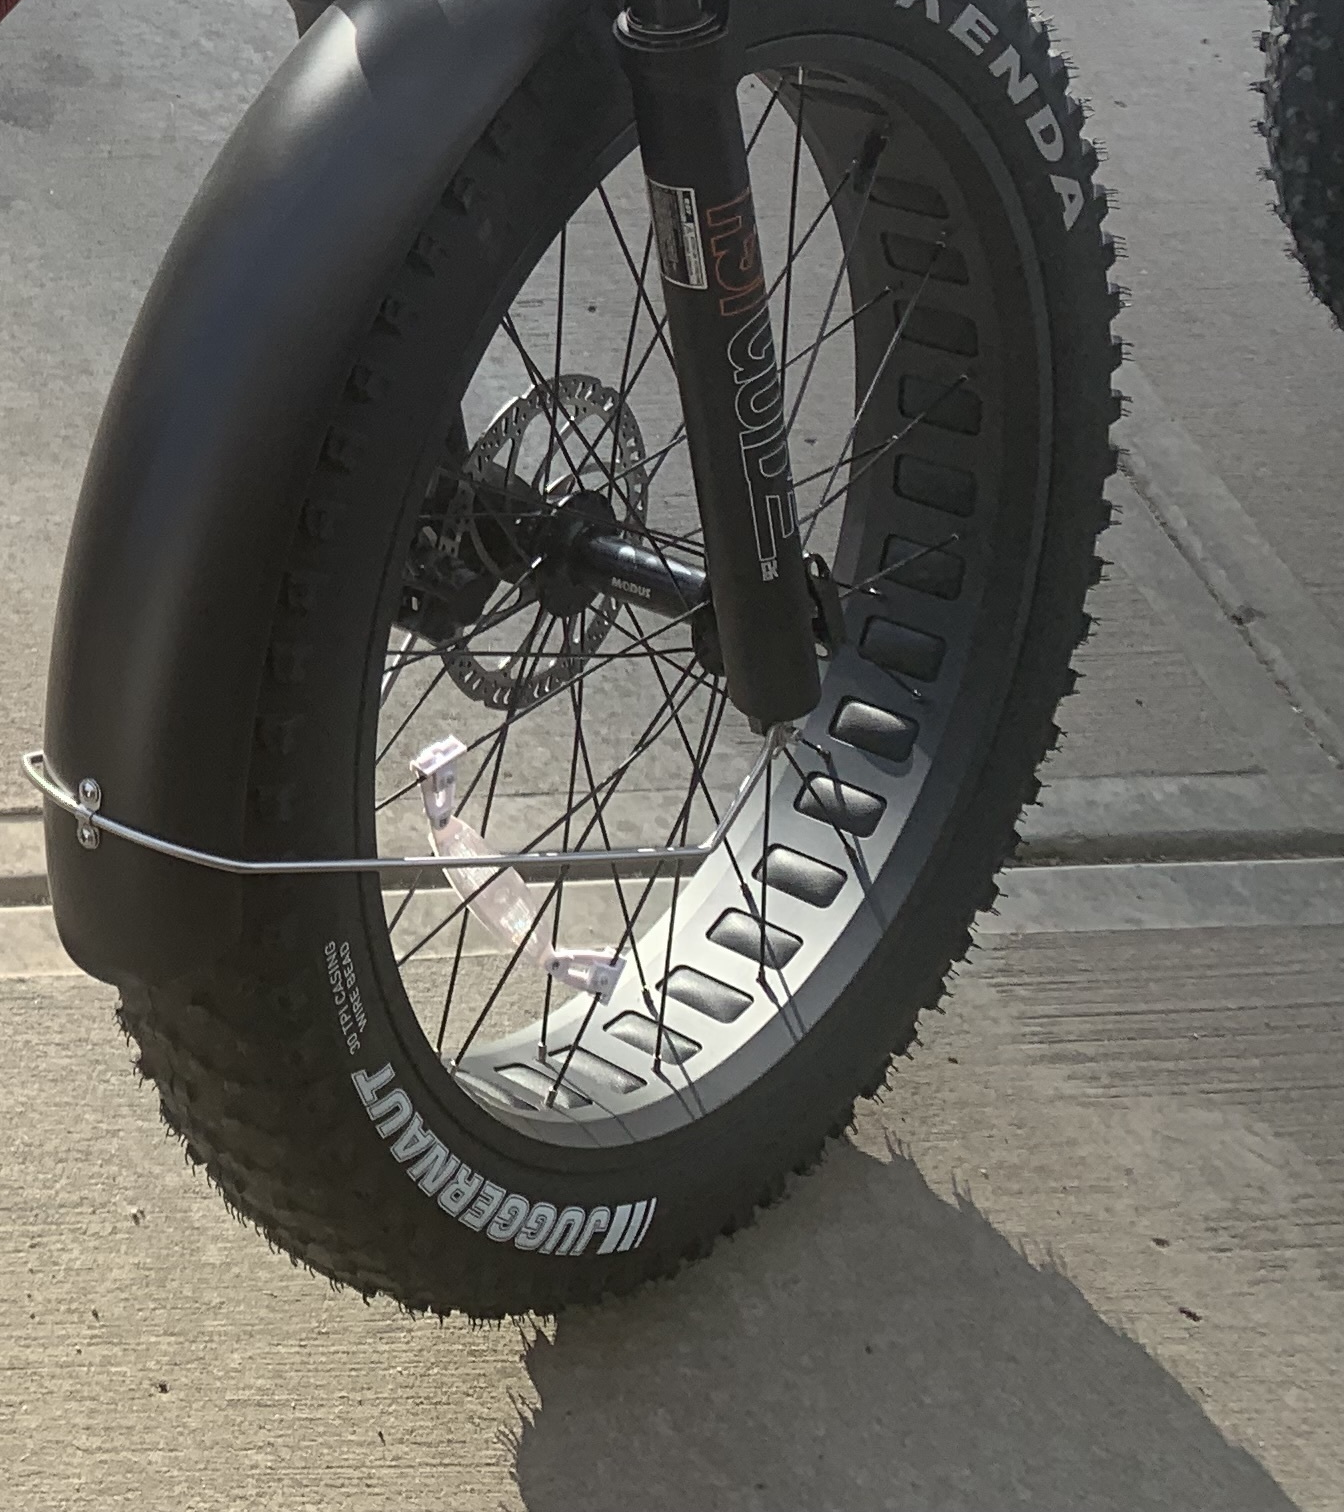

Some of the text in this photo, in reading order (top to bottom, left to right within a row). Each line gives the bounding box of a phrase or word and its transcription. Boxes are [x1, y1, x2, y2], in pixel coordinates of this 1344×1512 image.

[324, 940, 361, 1056] 30 TPI CASING
[339, 940, 368, 1033] WIRE BEAD
[350, 1061, 611, 1256] JUGGERNAUT
